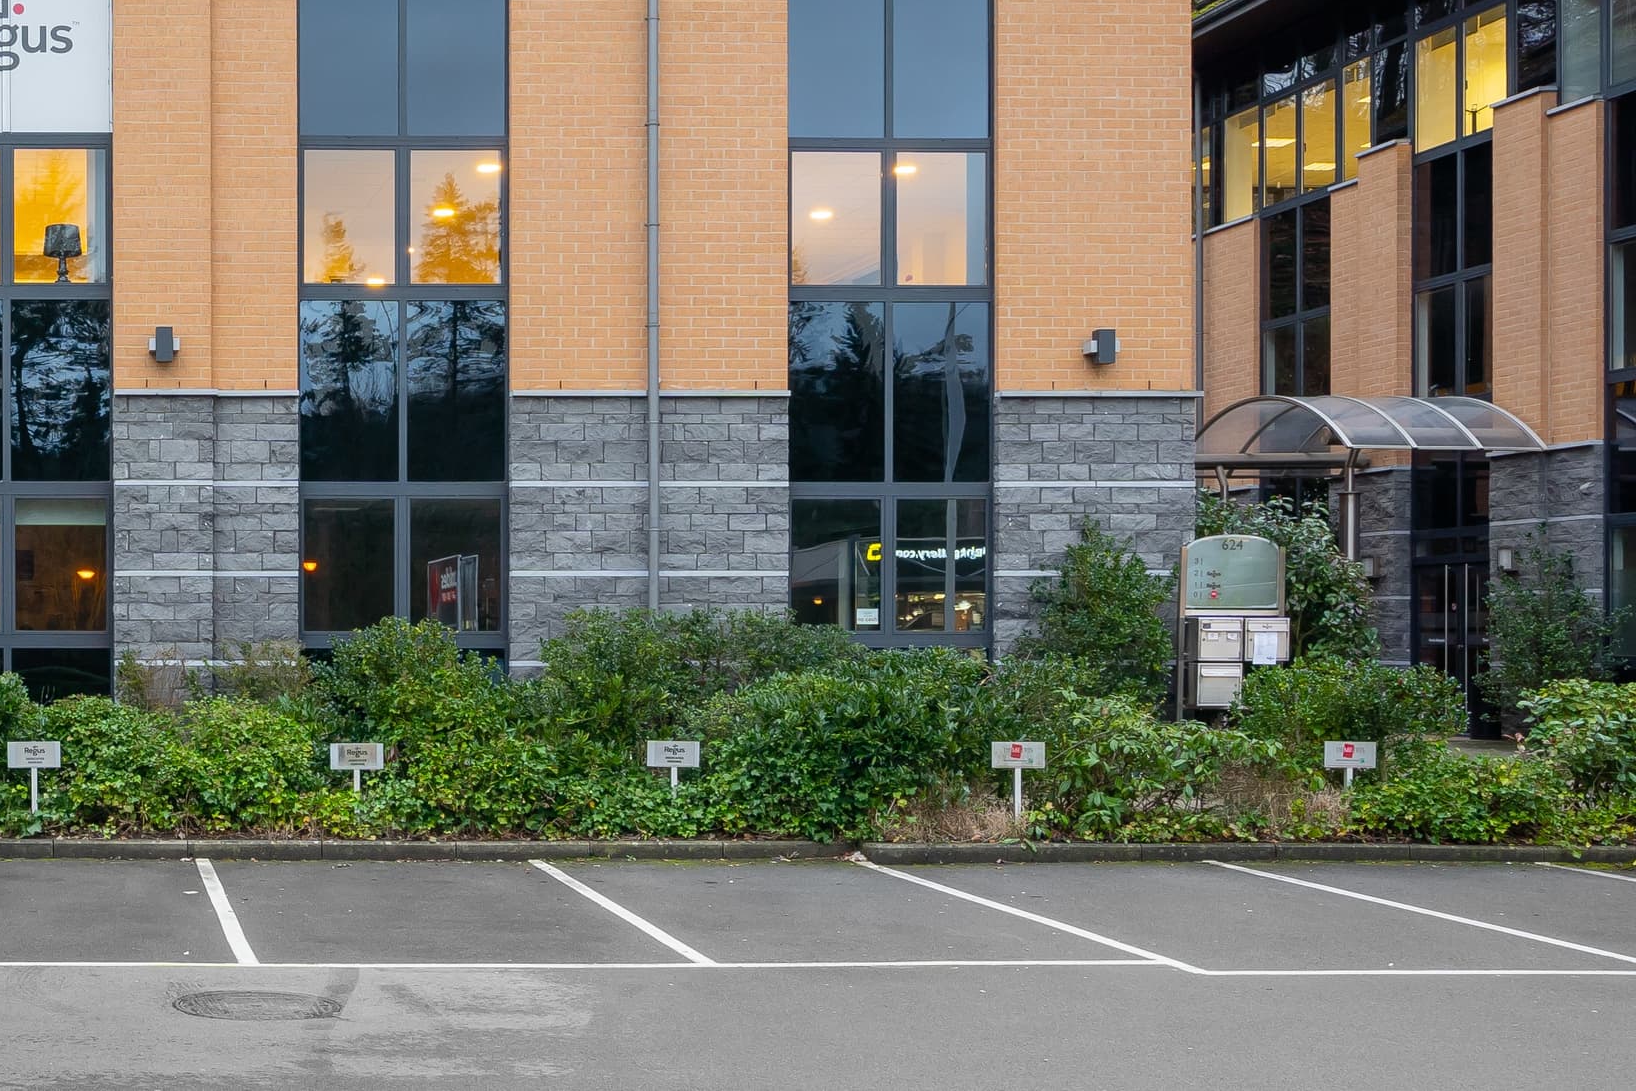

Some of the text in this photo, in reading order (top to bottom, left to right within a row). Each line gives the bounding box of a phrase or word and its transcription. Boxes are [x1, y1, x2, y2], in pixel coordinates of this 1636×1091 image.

[1221, 538, 1244, 551] 624
[24, 745, 46, 756] Regus
[346, 746, 368, 758] Regus
[663, 744, 686, 755] Regus
